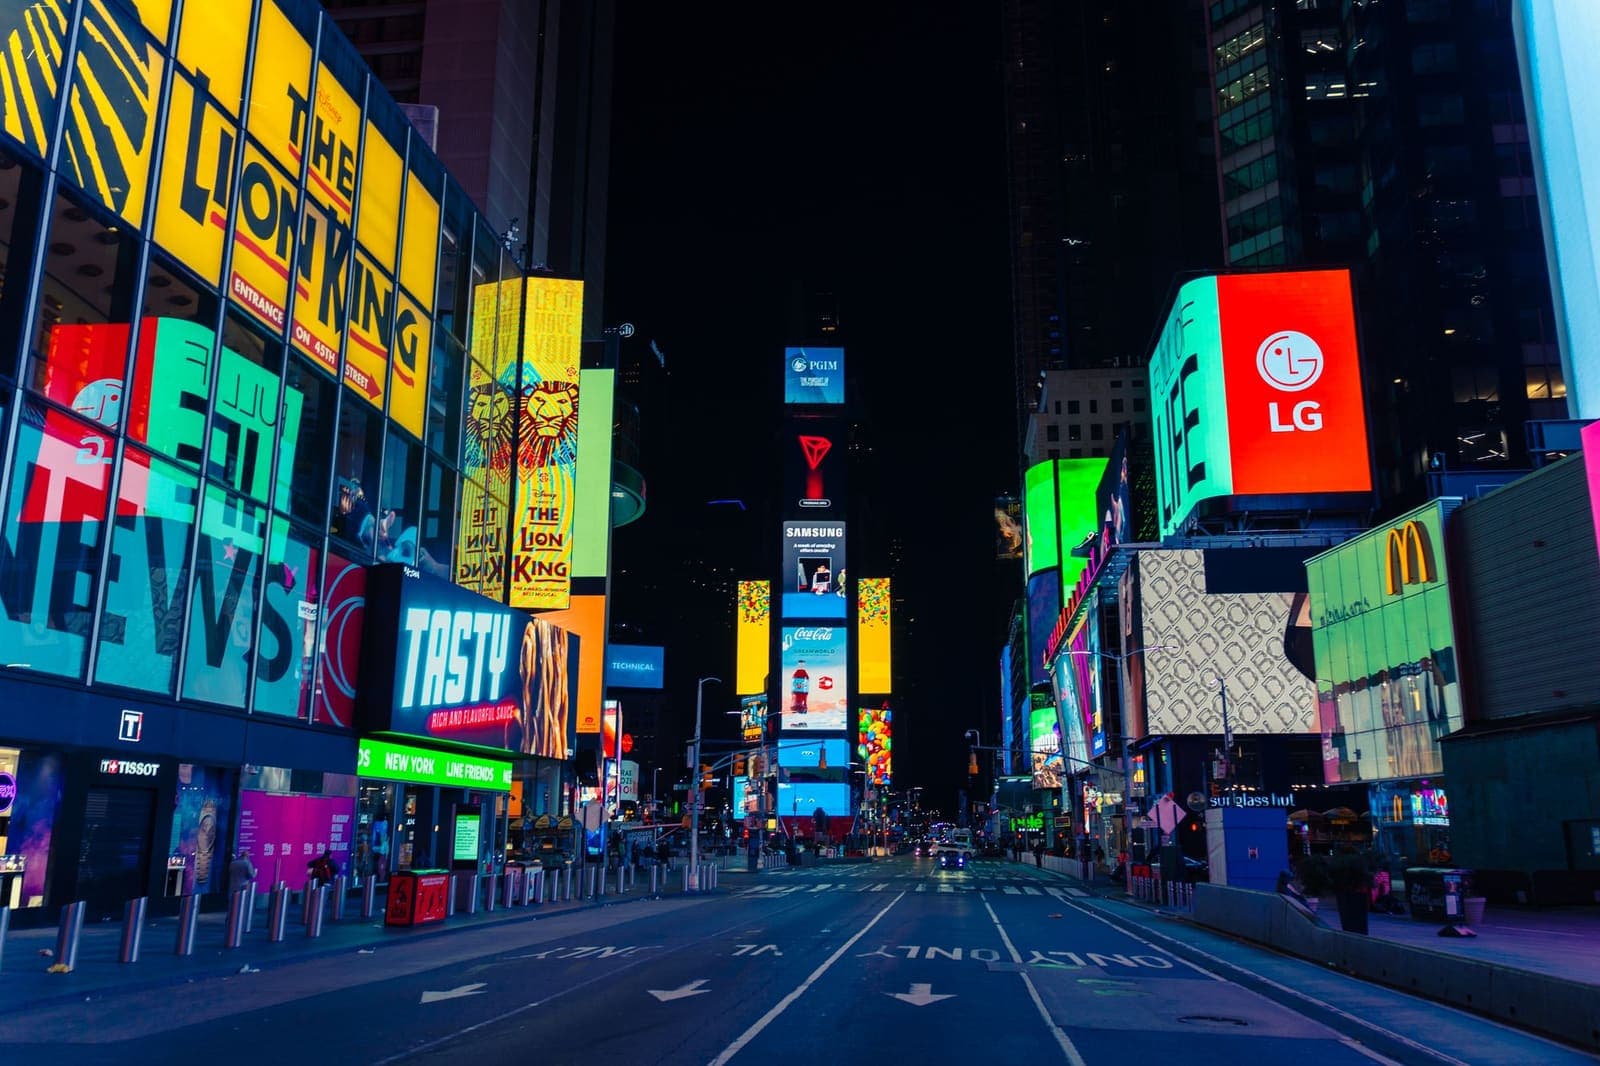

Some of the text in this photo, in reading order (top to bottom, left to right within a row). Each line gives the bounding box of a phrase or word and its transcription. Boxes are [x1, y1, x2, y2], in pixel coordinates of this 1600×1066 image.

[287, 83, 355, 200] THE
[180, 67, 314, 284] LION
[318, 201, 417, 373] KING
[234, 278, 369, 390] ENTRANCE ON 45TH STREET
[809, 360, 837, 371] PGIM
[1269, 401, 1323, 432] LG
[1157, 353, 1206, 529] LIFE
[528, 507, 559, 521] THE
[520, 527, 563, 552] LION
[786, 527, 843, 538] SAMSUNG
[513, 555, 567, 583] KING
[793, 627, 832, 641] Coca-Cola
[401, 607, 511, 708] TASTY
[612, 661, 655, 672] TECHNICAL
[431, 705, 514, 728] RICH AND FLAVORFUL SAUCE
[118, 761, 160, 776] TISSOT
[385, 752, 409, 772] NEW
[411, 757, 434, 775] YORK
[446, 761, 466, 778] LINE
[466, 763, 495, 782] FRIENDS
[856, 945, 1000, 962] ONLY
[1028, 951, 1174, 969] ONLY
